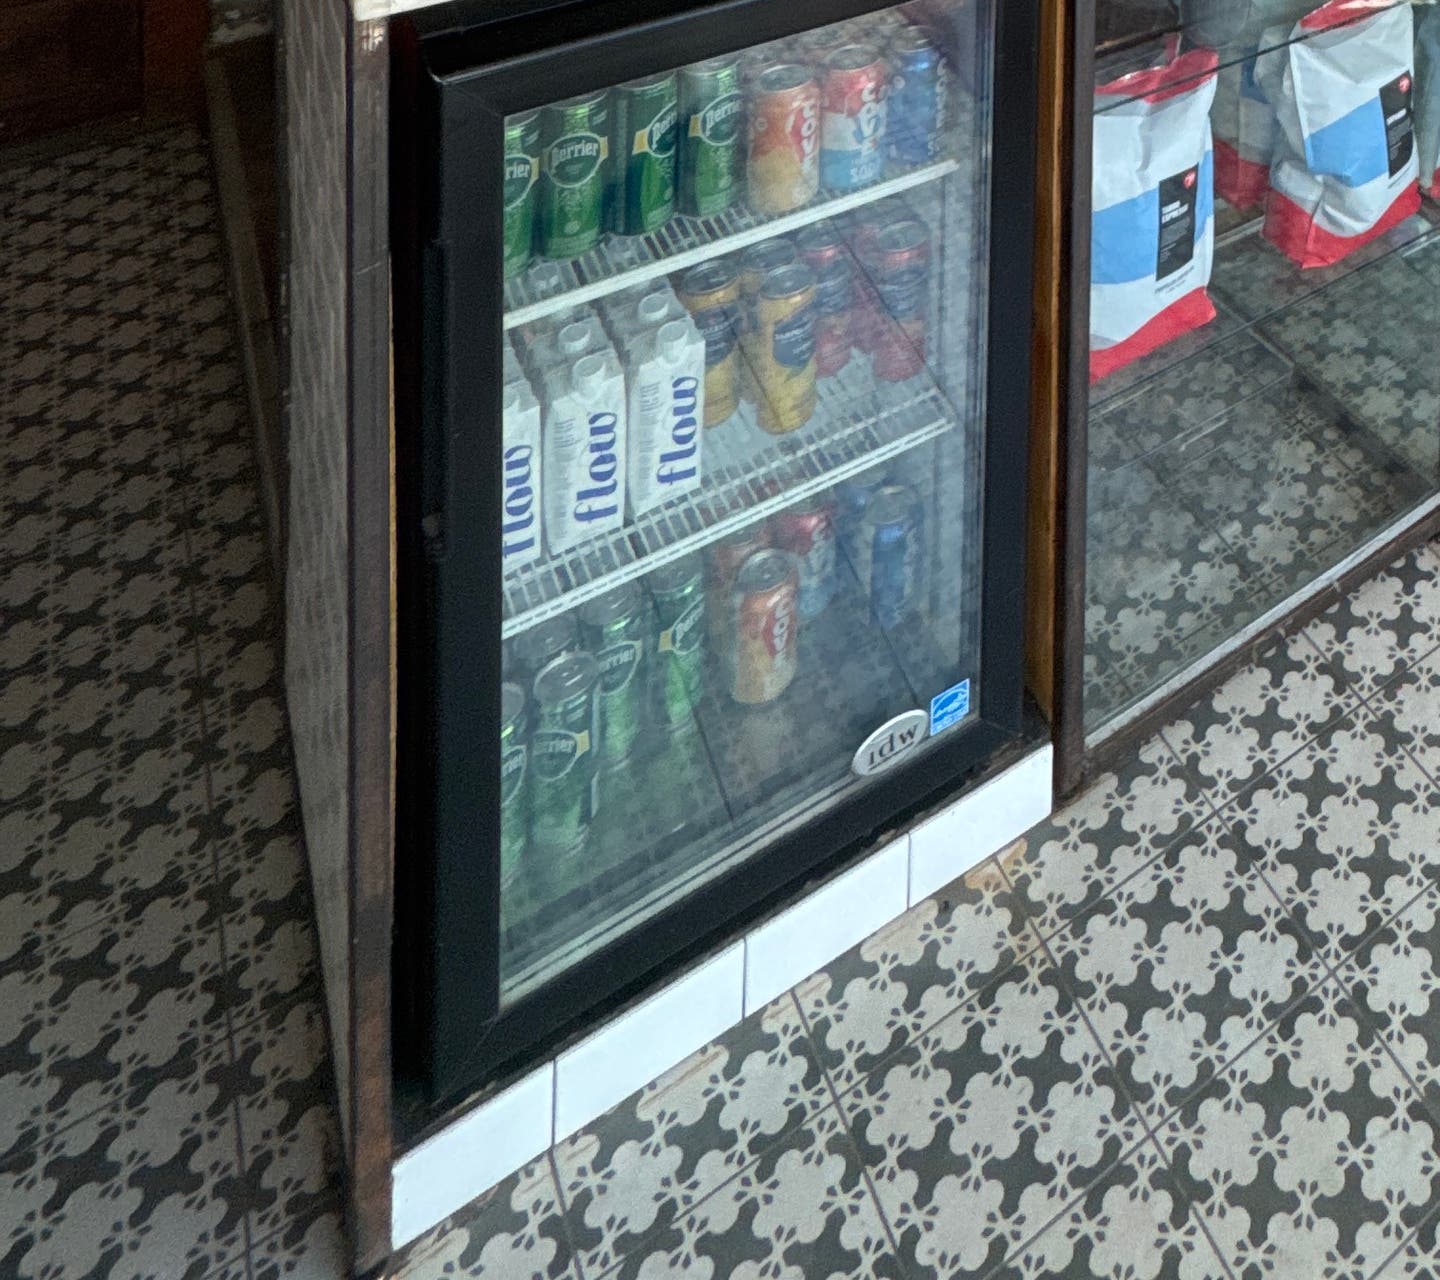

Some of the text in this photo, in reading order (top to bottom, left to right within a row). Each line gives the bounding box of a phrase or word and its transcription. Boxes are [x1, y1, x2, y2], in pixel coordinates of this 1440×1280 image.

[551, 139, 598, 169] Perrier
[573, 412, 618, 523] flow
[657, 376, 699, 485] flow
